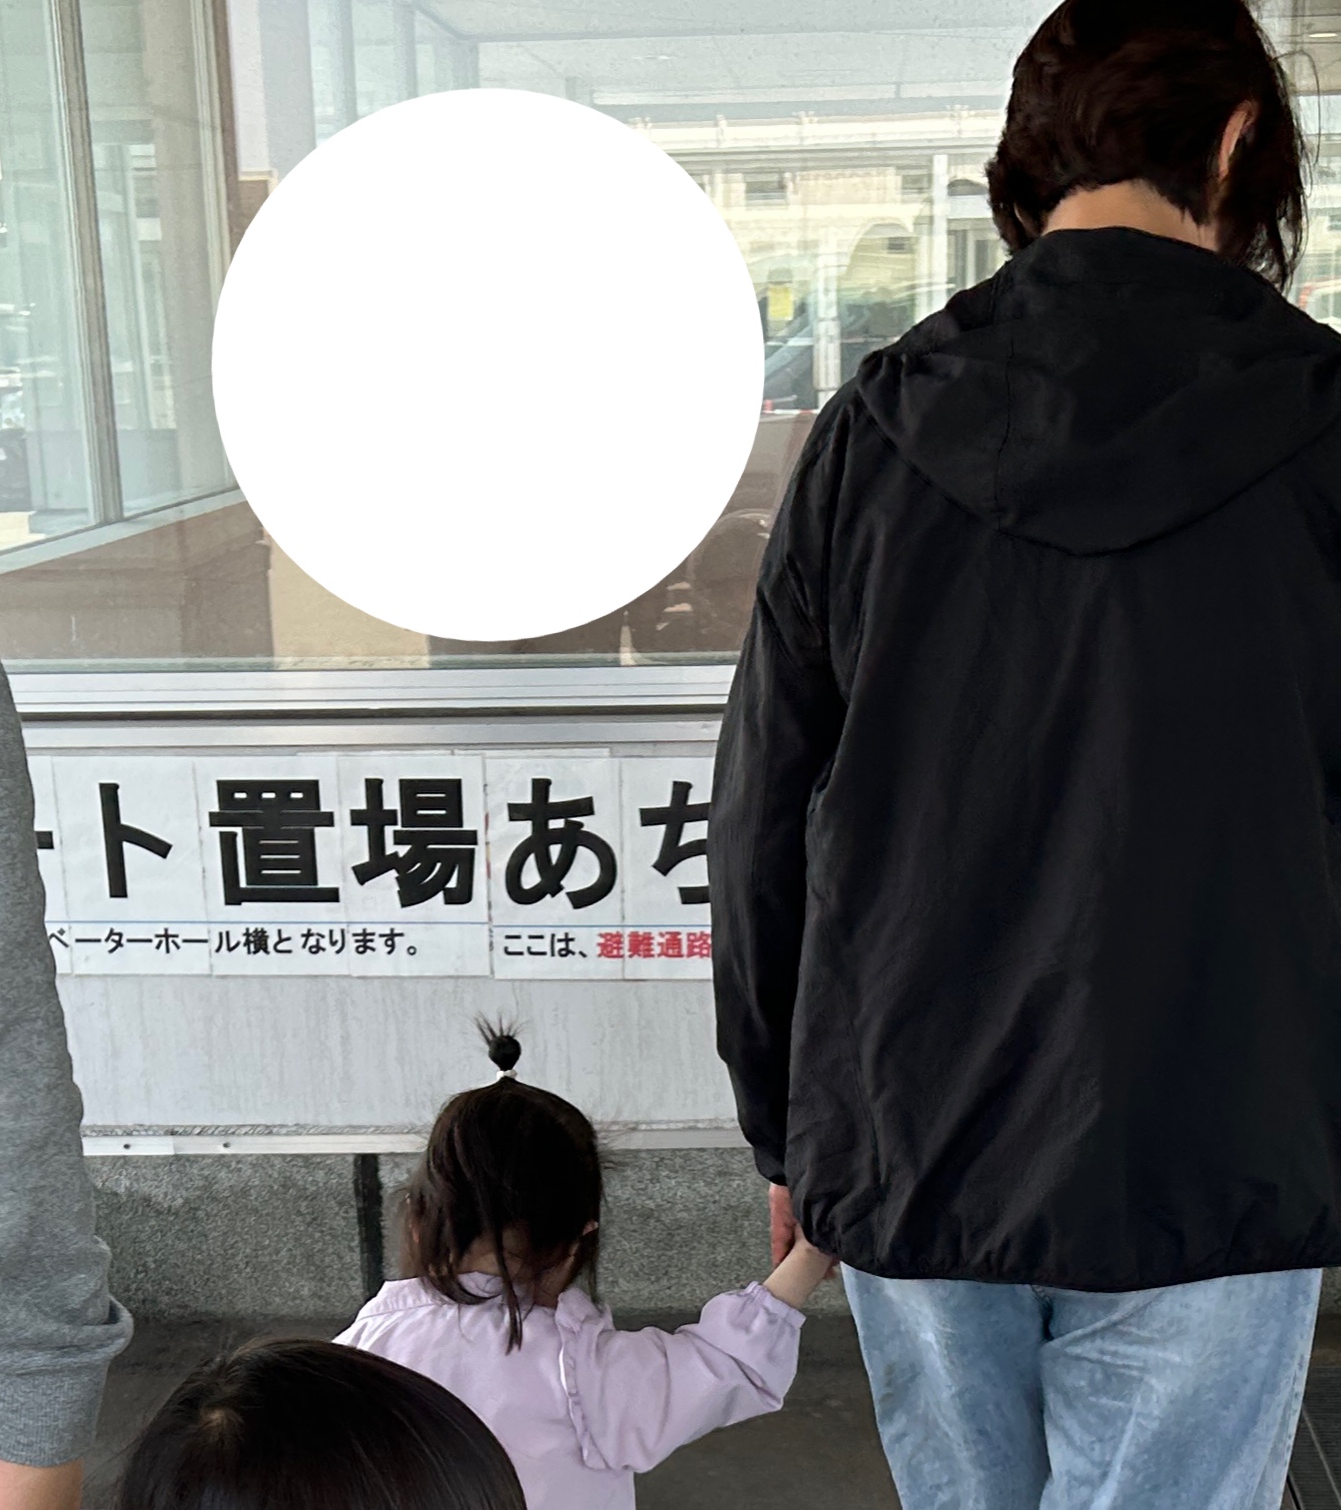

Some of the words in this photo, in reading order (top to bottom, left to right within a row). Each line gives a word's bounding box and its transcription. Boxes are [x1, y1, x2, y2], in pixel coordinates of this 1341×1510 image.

[34, 778, 712, 909] ト置場あち
